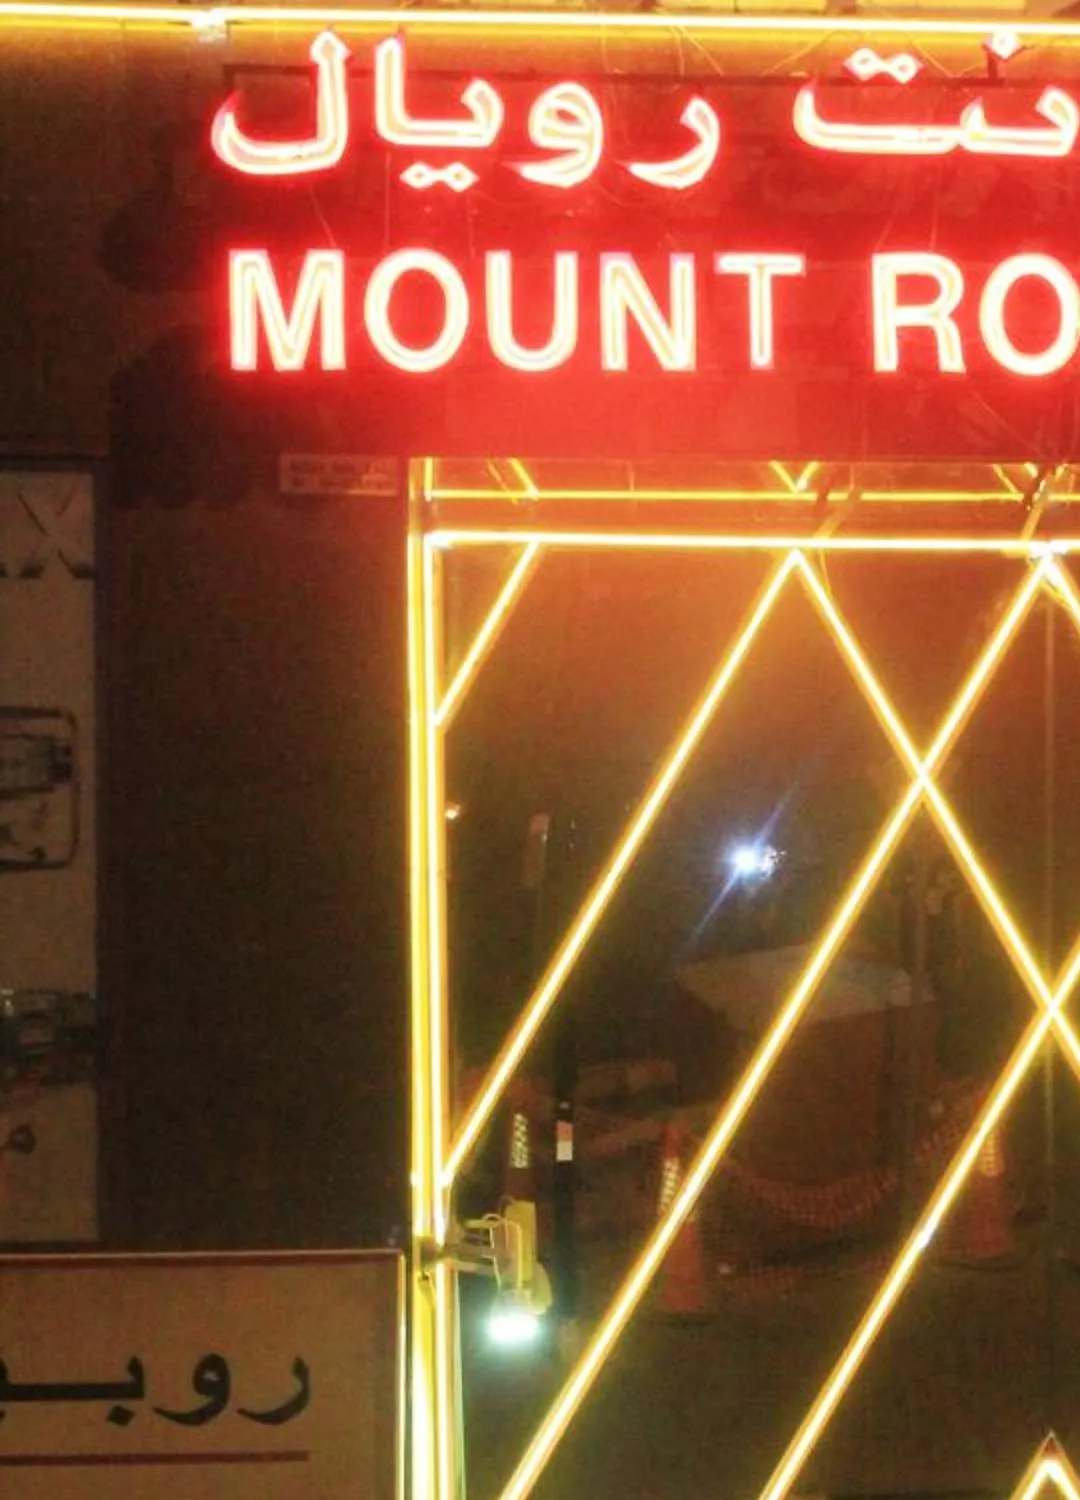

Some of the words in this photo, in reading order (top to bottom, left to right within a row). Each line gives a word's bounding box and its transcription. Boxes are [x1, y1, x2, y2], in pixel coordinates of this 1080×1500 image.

[211, 27, 720, 189] رويال
[228, 248, 806, 373] MOUNT
[0, 1353, 309, 1427] روب
